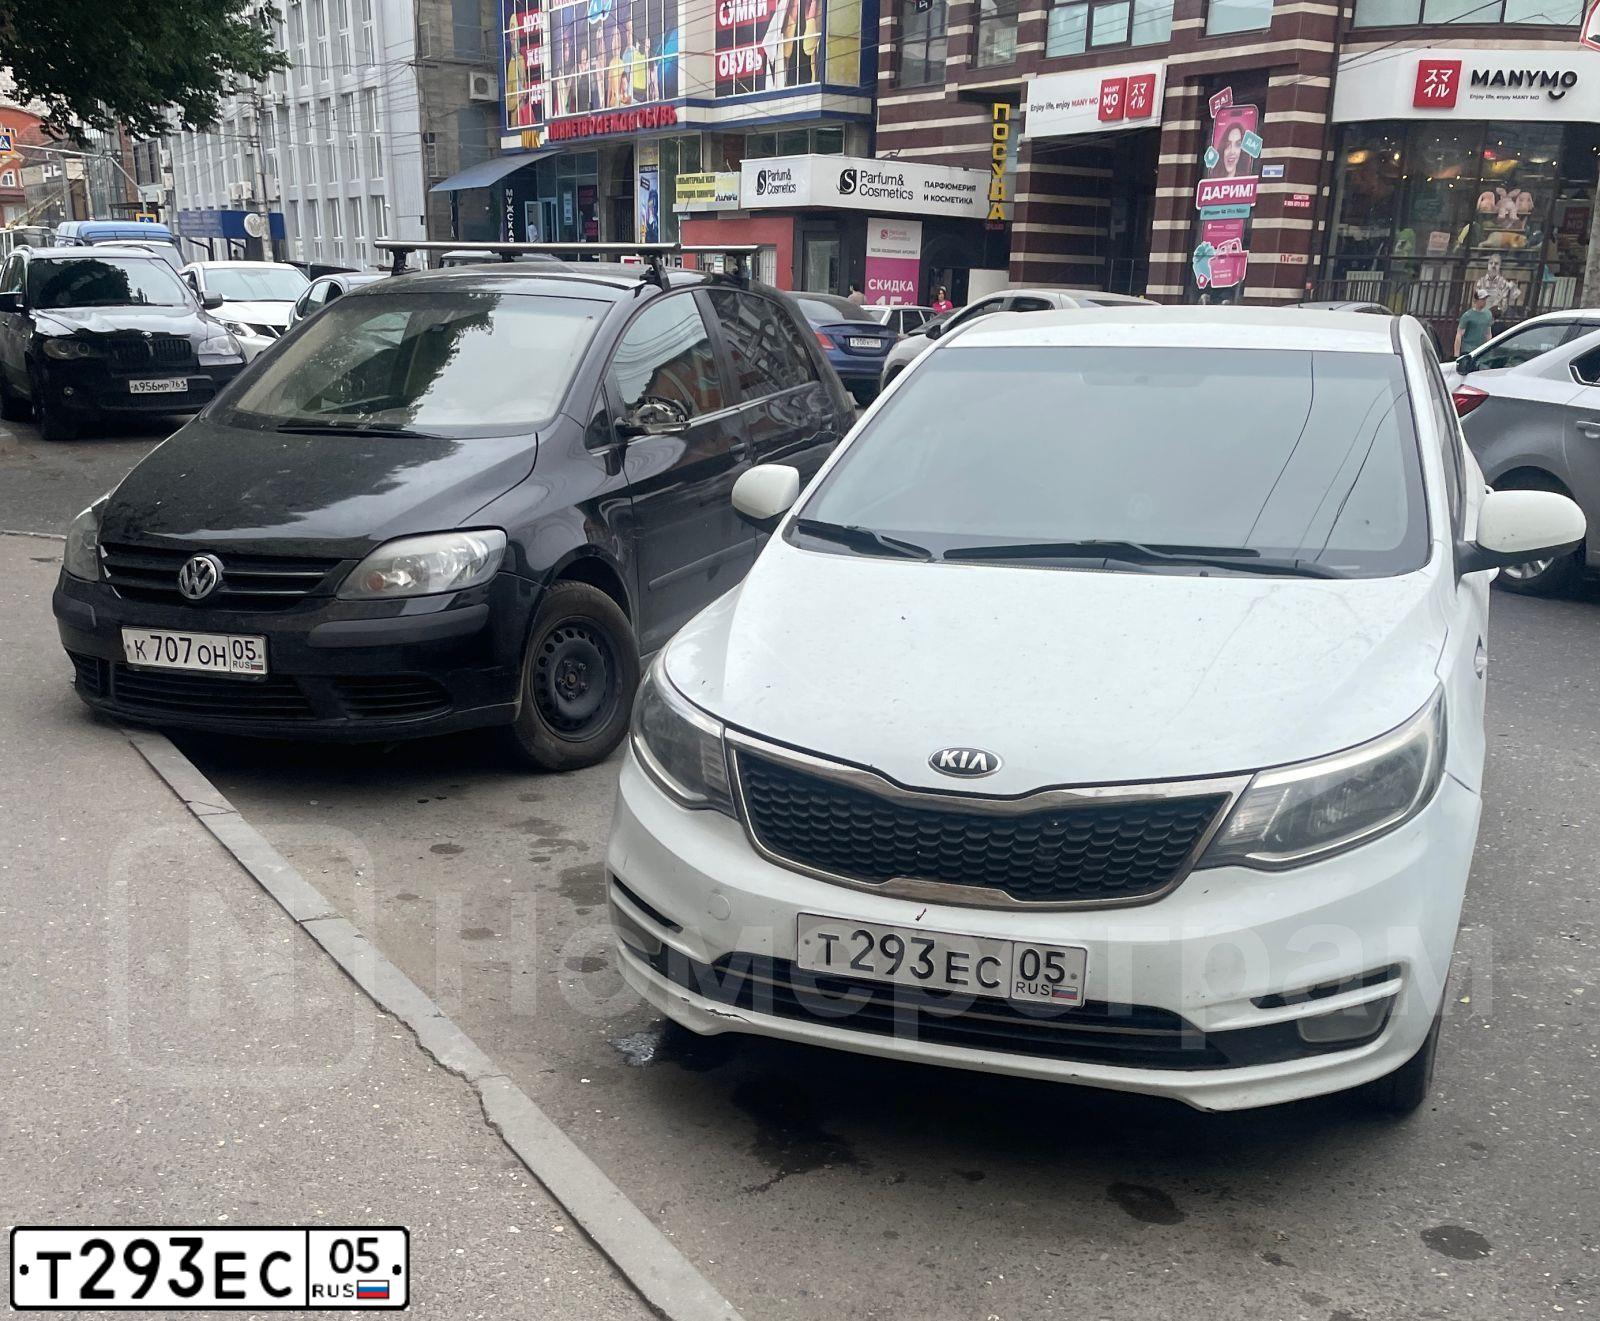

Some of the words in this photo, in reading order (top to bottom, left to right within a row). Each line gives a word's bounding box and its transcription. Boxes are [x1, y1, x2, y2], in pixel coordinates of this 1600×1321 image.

[719, 0, 768, 26] СУМКИ
[719, 47, 763, 77] ОБУВЬ
[1470, 69, 1578, 89] MANYMO
[1104, 85, 1120, 93] MANY
[1030, 104, 1045, 113] Enjoy
[1055, 100, 1071, 110] enjoy
[1071, 98, 1088, 107] MANY
[1088, 96, 1099, 105] MO
[1102, 93, 1119, 107] MO
[637, 104, 678, 130] ОБУВЬ
[987, 103, 1011, 221] ПОСУДА
[860, 170, 905, 187] Parfum&
[924, 180, 977, 193] ПАРФЮМЕРИЯ
[766, 182, 797, 196] Cosmetics
[859, 184, 914, 201] Cosmetics
[1201, 183, 1255, 202] ДАРИМ!
[923, 193, 929, 202] И
[930, 194, 974, 205] КОСМЕТИКА
[868, 278, 915, 294] СКИДКА
[133, 635, 228, 668] К707ОН
[232, 639, 257, 661] 05
[232, 660, 250, 670] RUS
[938, 750, 989, 772] KIA
[817, 928, 1003, 990] Т293ЕС
[1018, 947, 1067, 985] 05
[1014, 981, 1051, 997] RUS
